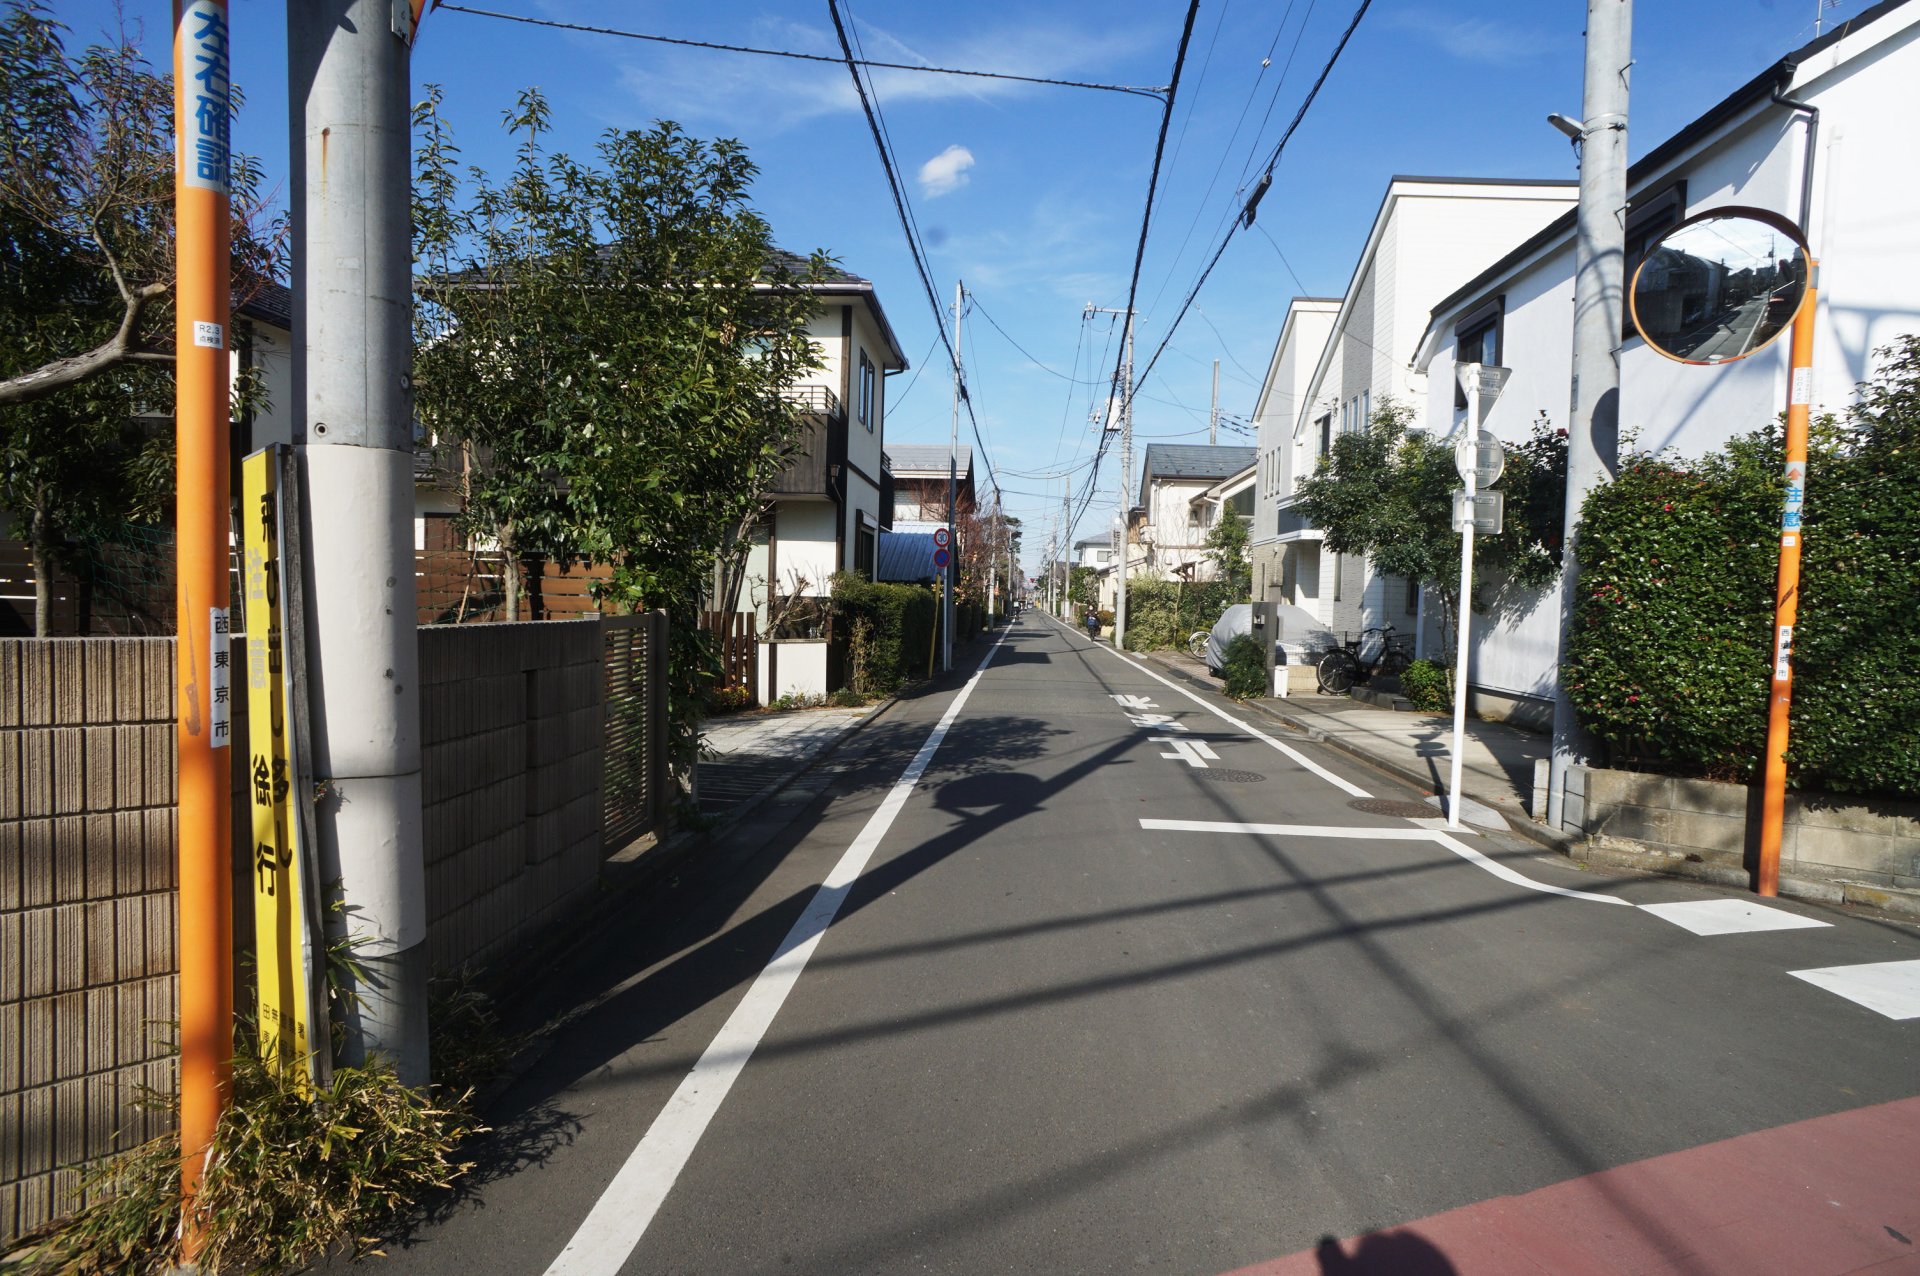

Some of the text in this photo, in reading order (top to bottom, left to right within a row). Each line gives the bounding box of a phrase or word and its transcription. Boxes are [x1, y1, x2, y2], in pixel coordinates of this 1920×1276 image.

[194, 11, 231, 188] 左右確認
[214, 615, 229, 738] 西東京市
[1109, 694, 1221, 768] 止まれ
[252, 753, 277, 897] 徐行
